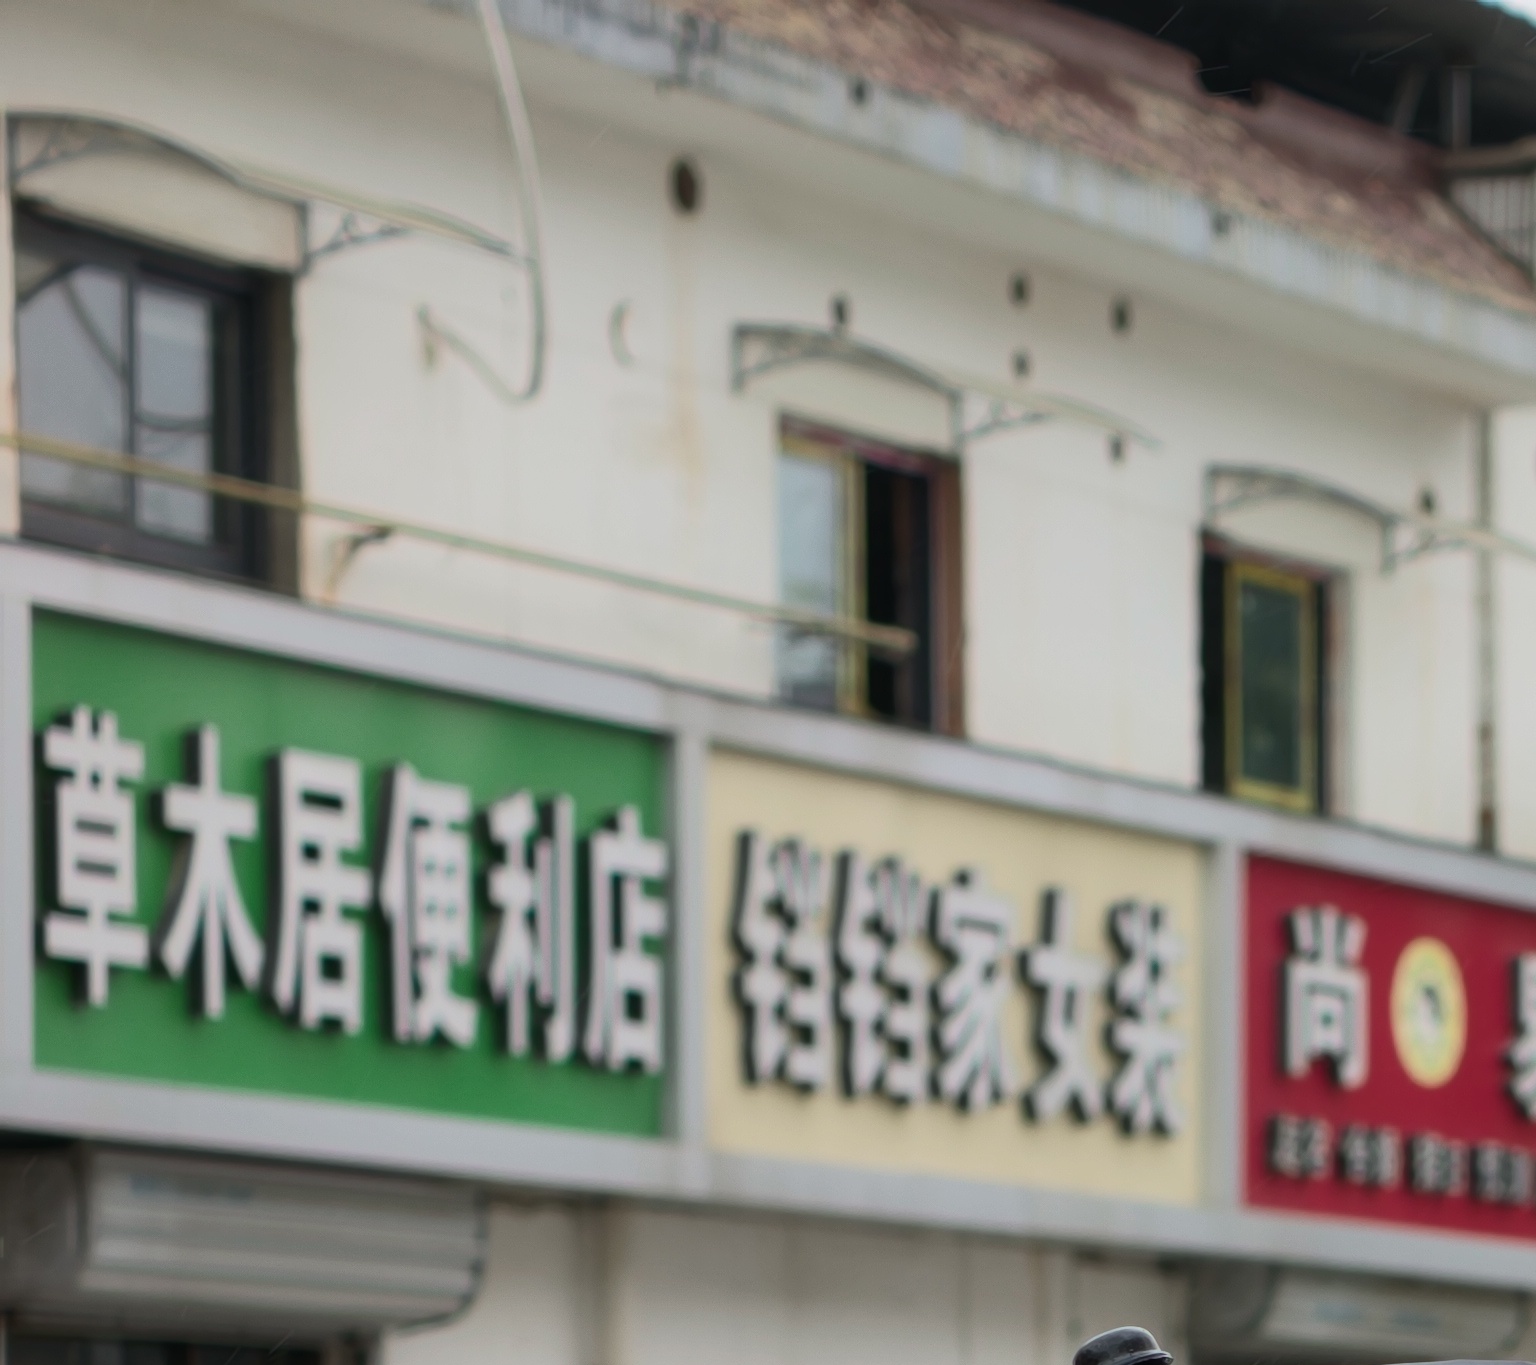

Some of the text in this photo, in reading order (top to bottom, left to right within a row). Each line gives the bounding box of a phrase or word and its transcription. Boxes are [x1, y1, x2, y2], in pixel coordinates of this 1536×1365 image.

[40, 702, 670, 1076] 草木居便利店
